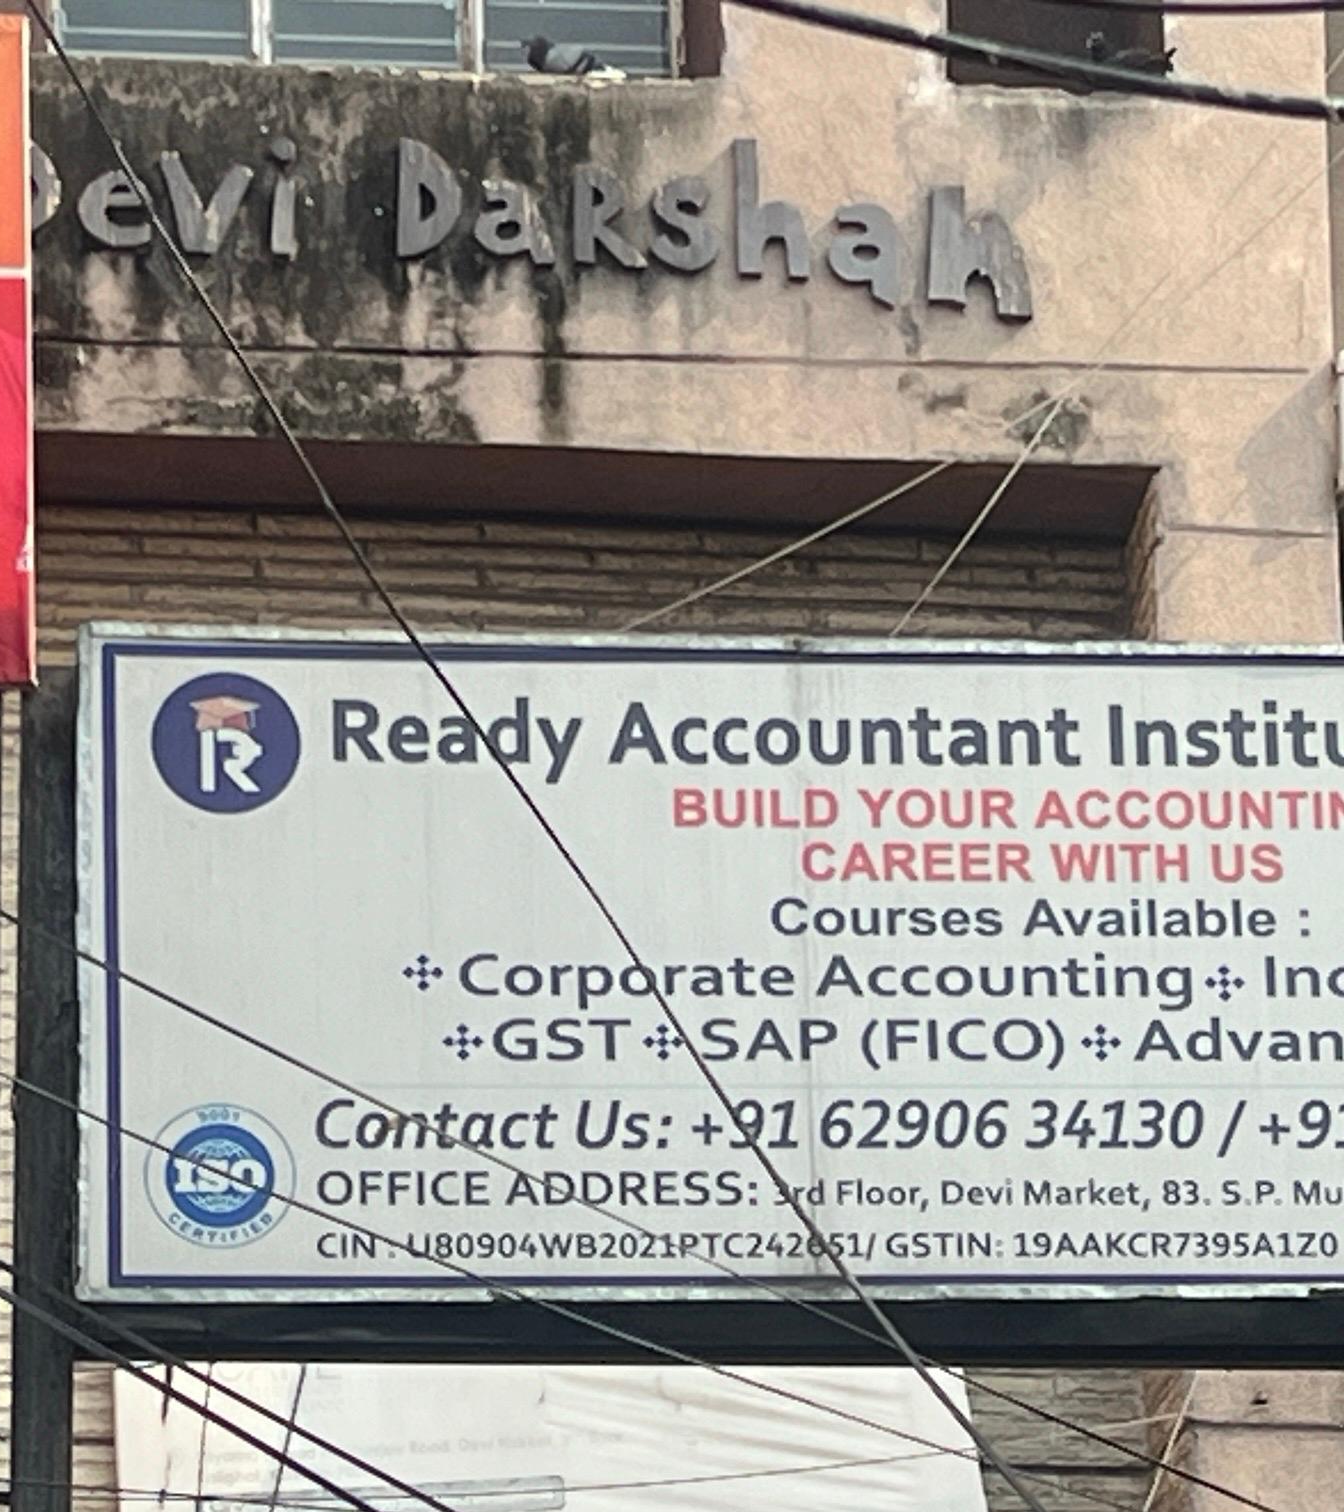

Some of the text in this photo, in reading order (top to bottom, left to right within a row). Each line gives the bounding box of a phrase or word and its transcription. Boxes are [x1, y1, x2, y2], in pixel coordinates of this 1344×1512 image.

[332, 697, 581, 784] Ready
[609, 702, 1081, 765] Accountant
[673, 789, 839, 828] BUILD
[858, 789, 1016, 828] YOUR
[801, 843, 1284, 883] CAREER WITH US
[770, 898, 1002, 937] Courses
[1023, 899, 1277, 937] Available
[458, 954, 796, 1009] Corporate
[816, 954, 1194, 1012] Accounting
[492, 1019, 631, 1061] GST
[700, 1019, 837, 1062] SAP
[861, 1019, 1065, 1071] (FICO)
[315, 1100, 558, 1149] Contact
[576, 1100, 673, 1149] Us:
[691, 1100, 799, 1149] +91
[819, 1100, 1008, 1149] 62906
[1024, 1100, 1204, 1149] 34130
[1217, 1099, 1247, 1158] /
[173, 1157, 268, 1193] ISO
[316, 1170, 490, 1206] OFFICE
[505, 1170, 759, 1207] ADDRESS:
[773, 1177, 826, 1206] rd
[836, 1179, 929, 1212] Floor,
[941, 1178, 1013, 1205] Devi
[1023, 1178, 1151, 1212] Market,
[1163, 1179, 1212, 1206] 83.
[1222, 1179, 1283, 1206] S.P.
[168, 1210, 273, 1244] CERTIFIED
[316, 1232, 376, 1259] CIN
[886, 1232, 1004, 1259] GSTIN:
